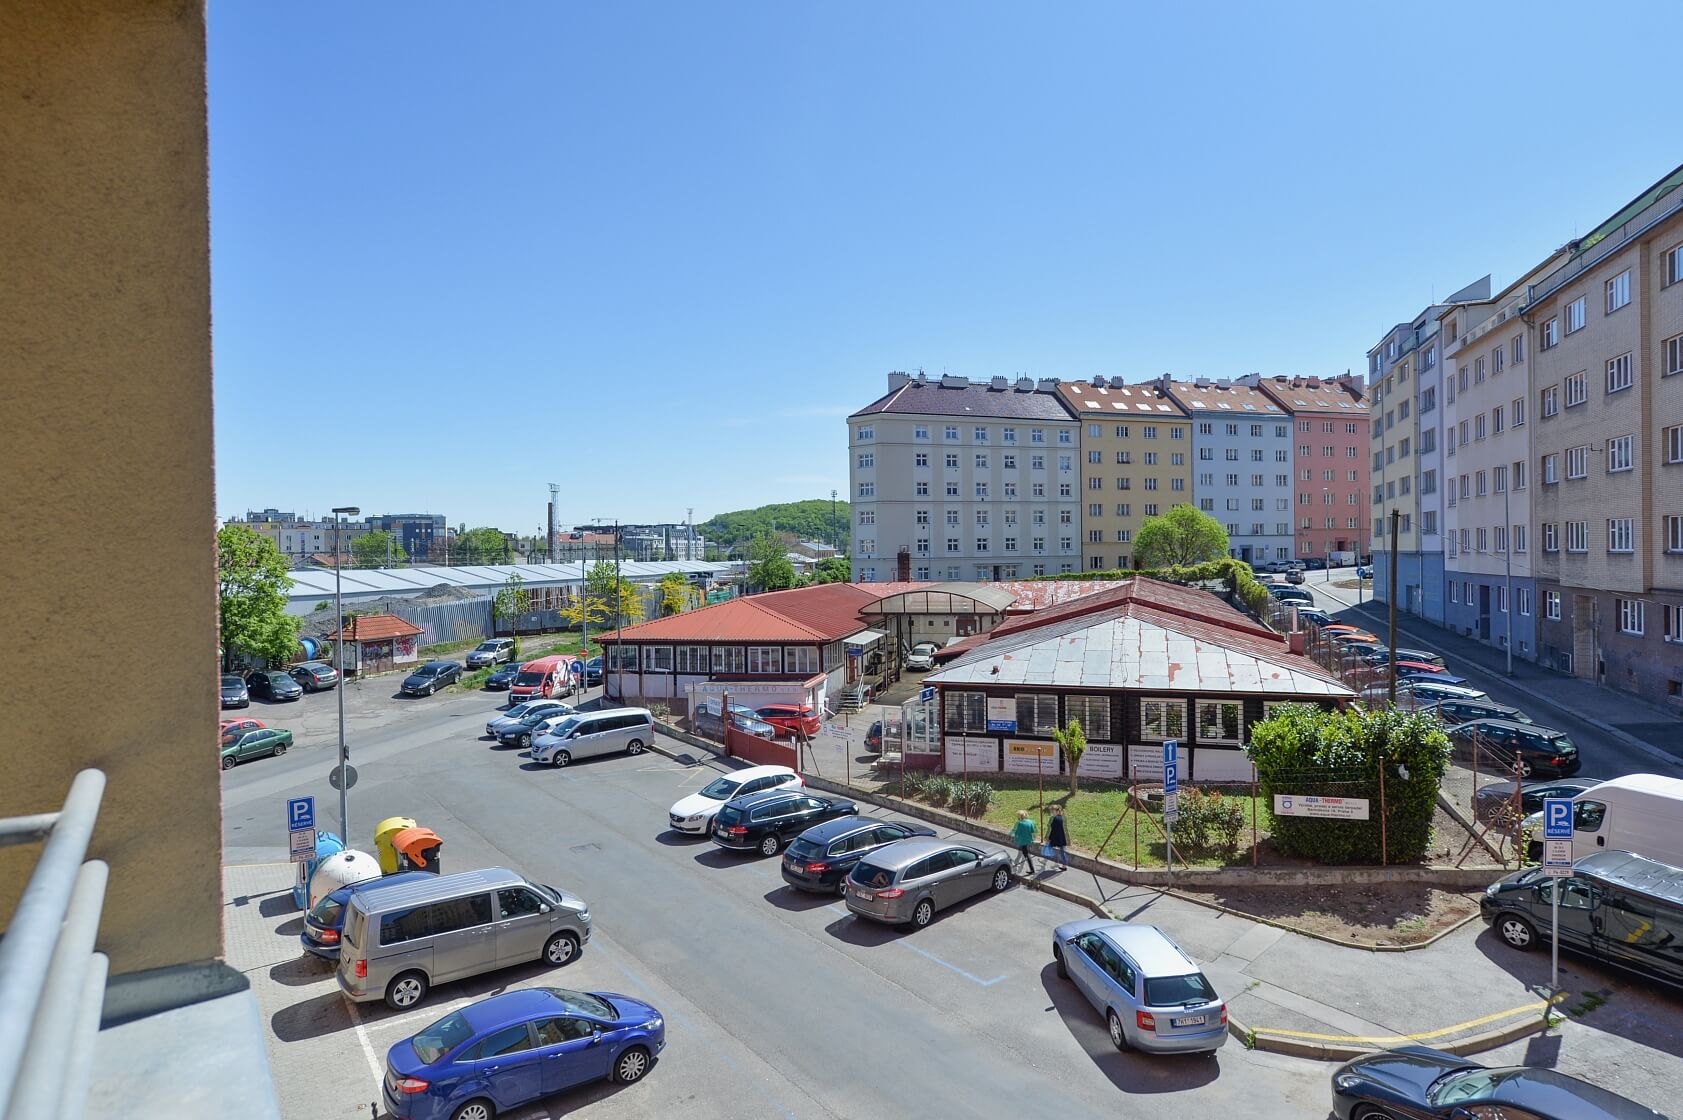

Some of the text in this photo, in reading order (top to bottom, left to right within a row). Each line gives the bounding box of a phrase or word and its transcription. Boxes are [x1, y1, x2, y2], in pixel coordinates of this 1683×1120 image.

[1167, 767, 1175, 785] P
[294, 802, 308, 821] P
[1551, 804, 1567, 827] P
